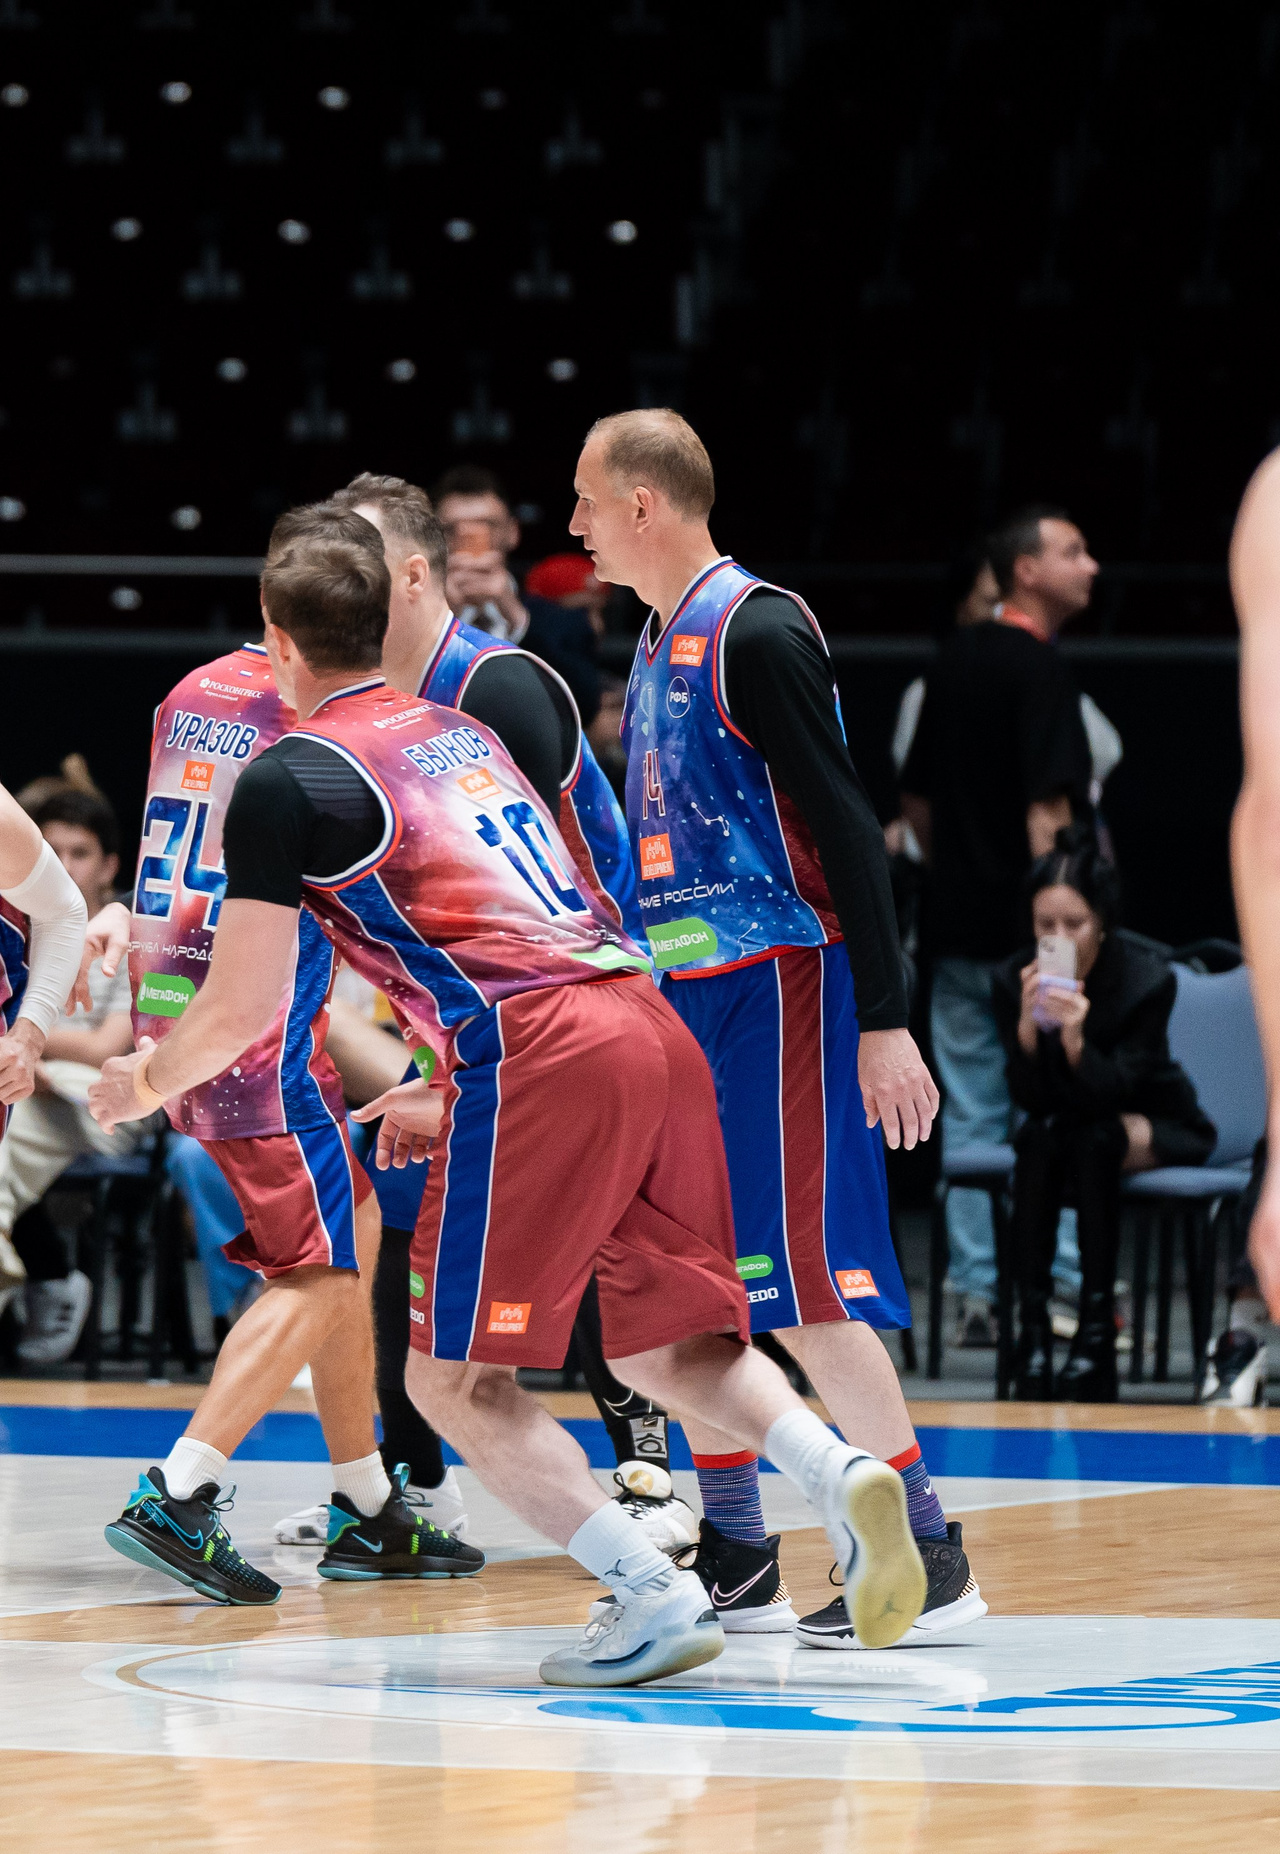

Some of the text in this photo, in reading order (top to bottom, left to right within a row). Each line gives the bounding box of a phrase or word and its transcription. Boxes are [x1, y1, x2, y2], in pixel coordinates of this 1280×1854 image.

[669, 691, 688, 703] РФБ
[165, 710, 259, 762] УРАЗОВ
[401, 727, 492, 777] БЫКОВ
[642, 748, 666, 820] 14
[133, 793, 228, 931] 24
[473, 797, 593, 921] 10
[664, 883, 735, 904] РОССИИ
